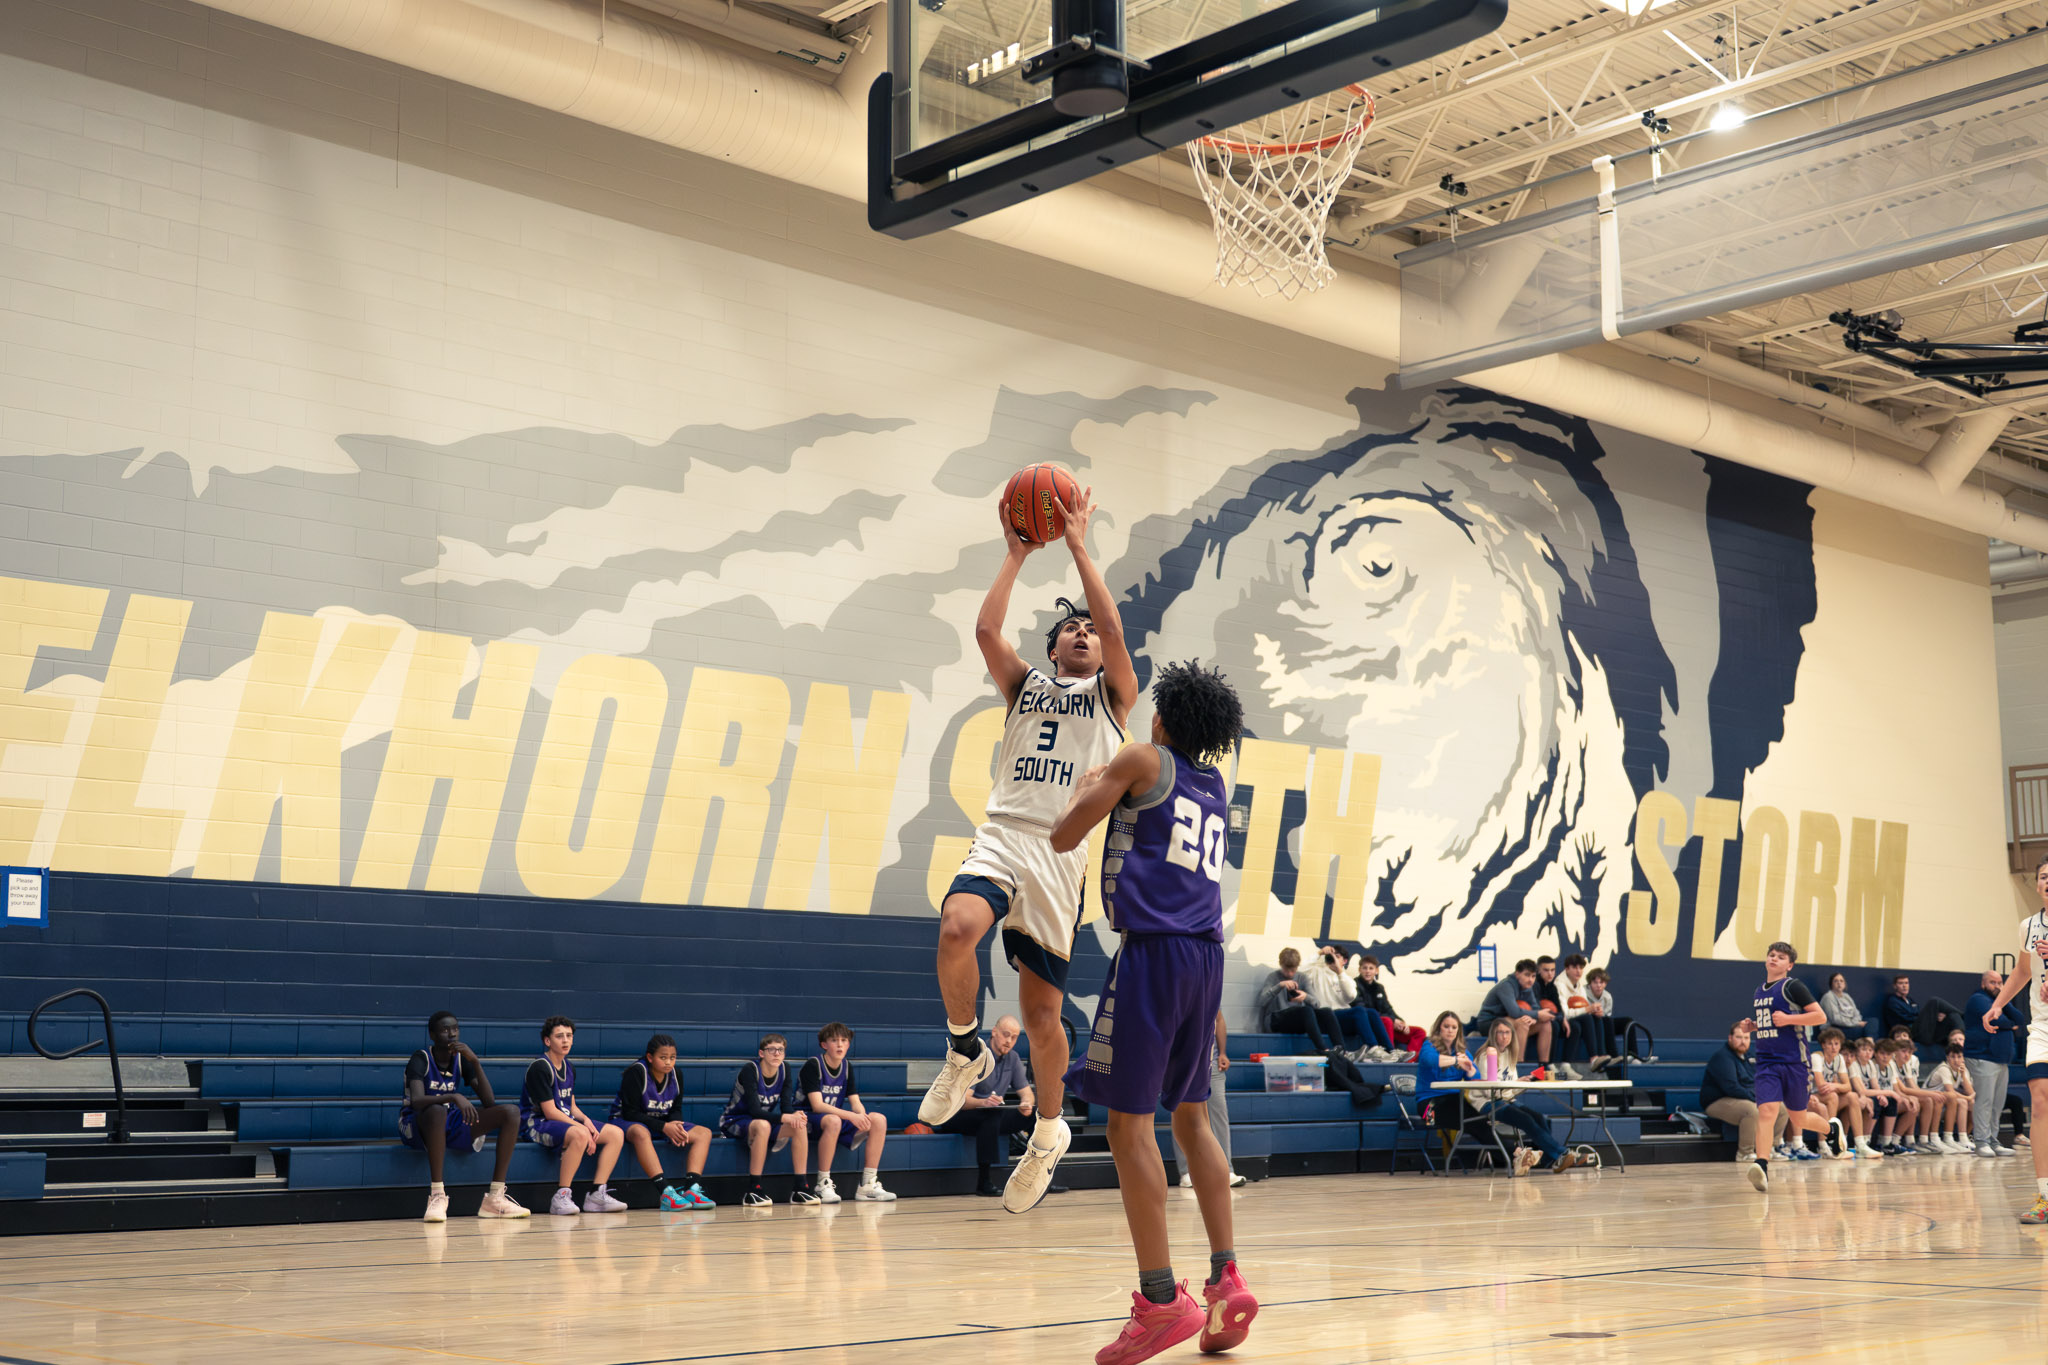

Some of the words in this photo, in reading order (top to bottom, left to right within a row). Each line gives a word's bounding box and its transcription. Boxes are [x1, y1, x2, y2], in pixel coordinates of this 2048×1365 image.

[1046, 513, 1055, 540] ELITE
[1019, 691, 1095, 719] ELKHORN
[1037, 720, 1059, 751] 3
[0, 576, 912, 915] ELKHORN
[1626, 790, 1909, 968] STORM
[1013, 757, 1074, 787] SOUTH
[1165, 795, 1226, 884] 20
[1753, 997, 1774, 1007] EAST
[1756, 1008, 1772, 1028] 22
[429, 1080, 457, 1091] EAS
[647, 1099, 674, 1110] EAST
